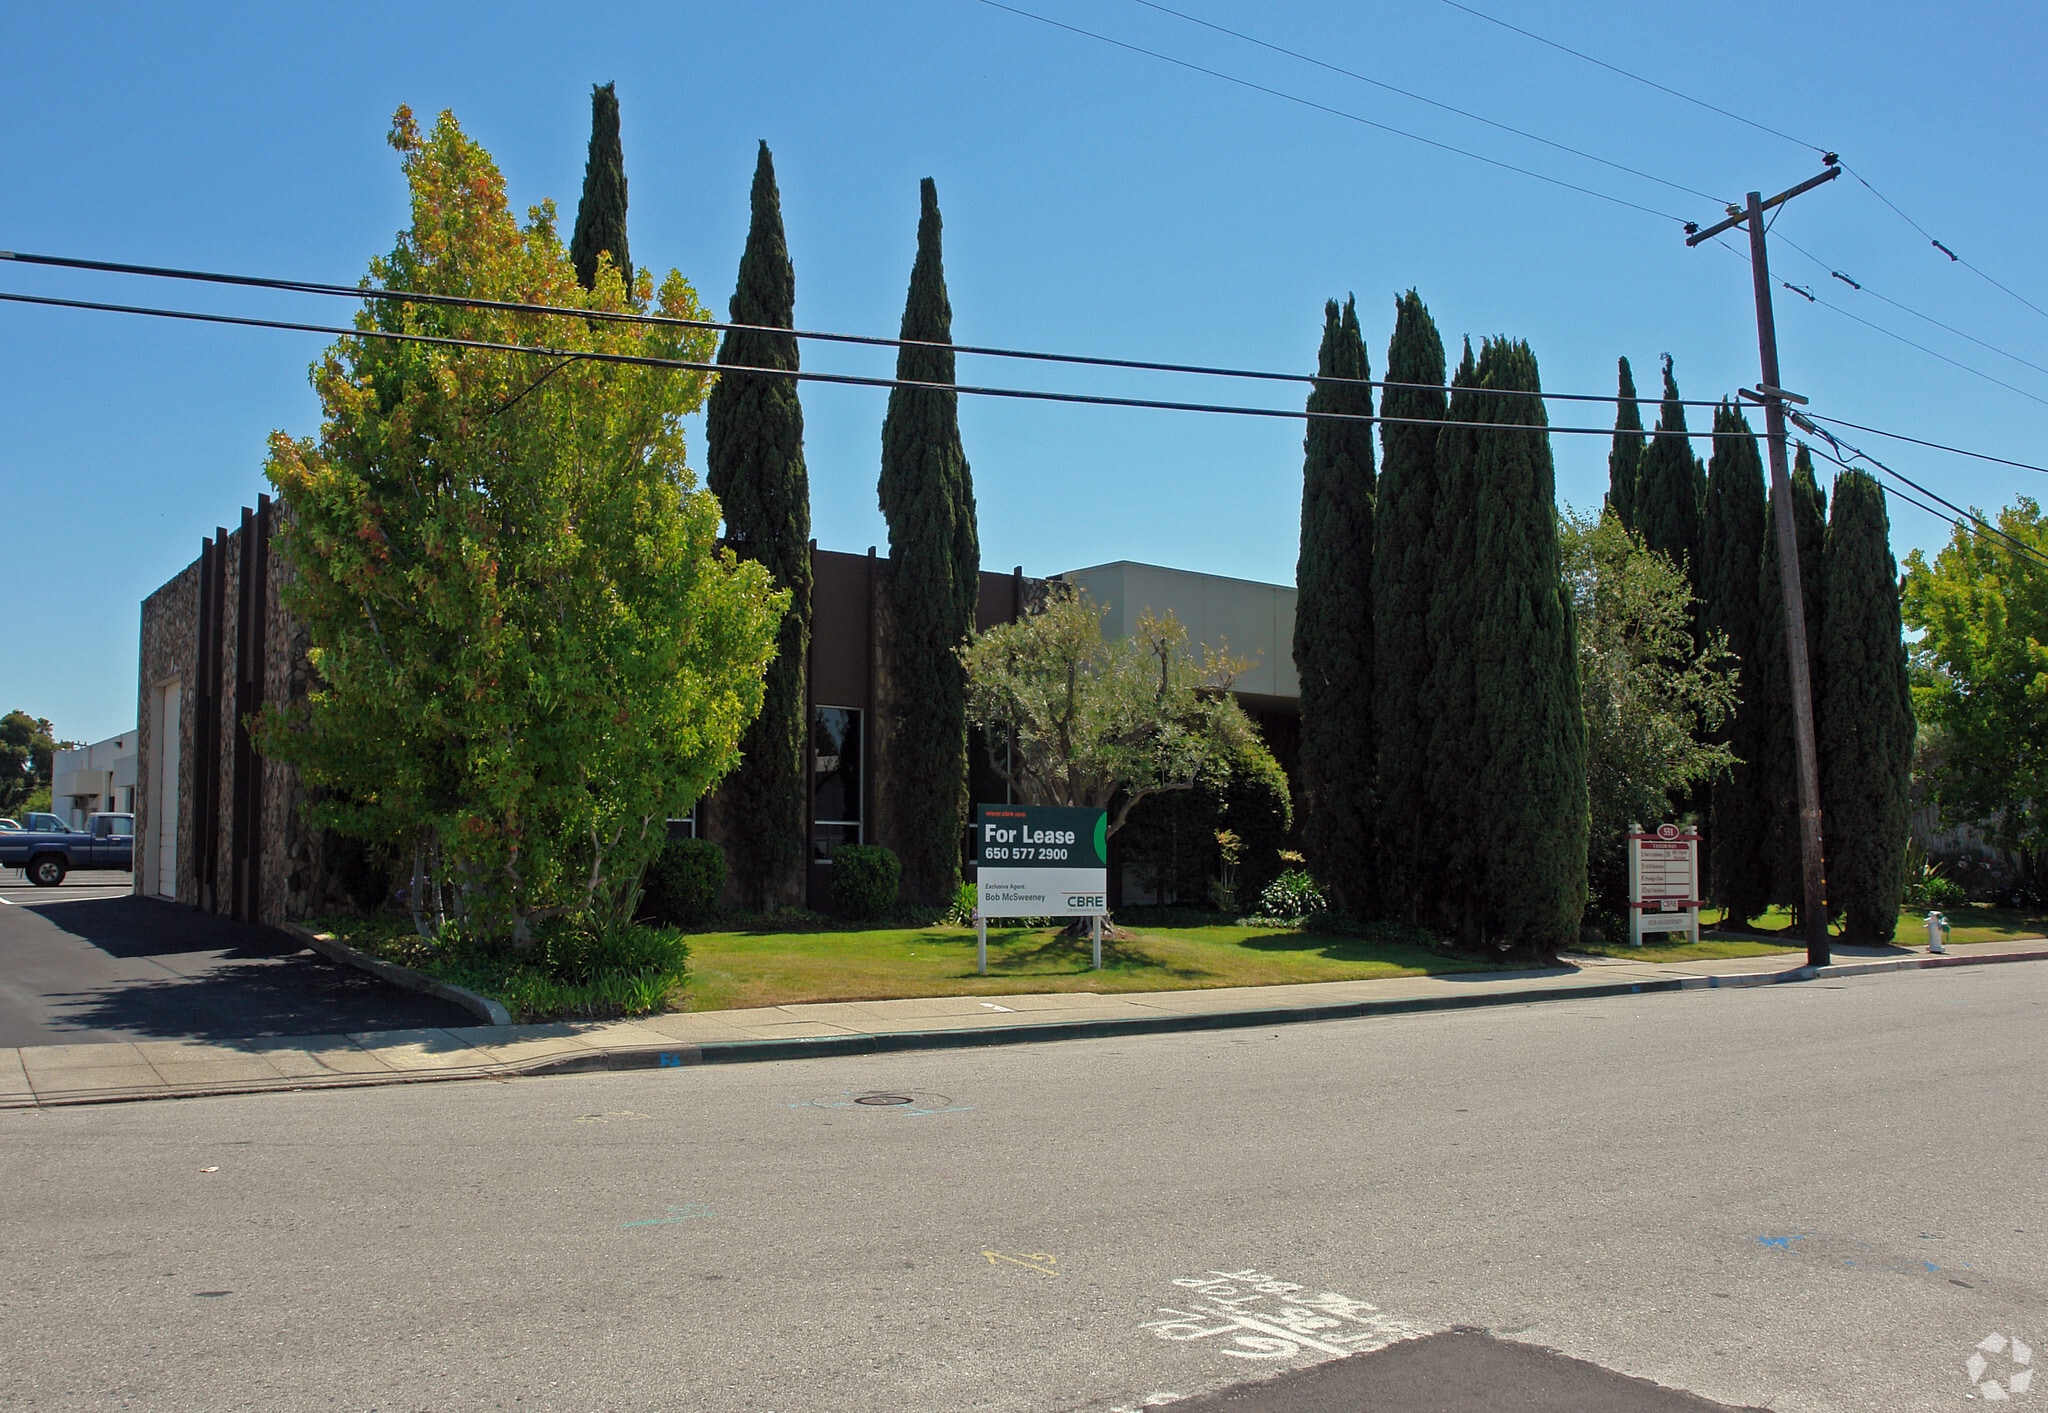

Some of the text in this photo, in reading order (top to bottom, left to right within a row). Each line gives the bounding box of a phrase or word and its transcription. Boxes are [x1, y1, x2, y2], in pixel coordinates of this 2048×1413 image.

[985, 824, 1075, 844] For Lease
[1663, 828, 1674, 836] 551
[985, 848, 1068, 860] 650 577 2900
[985, 893, 1046, 903] Bob McSweeney
[1067, 896, 1103, 907] CBRE
